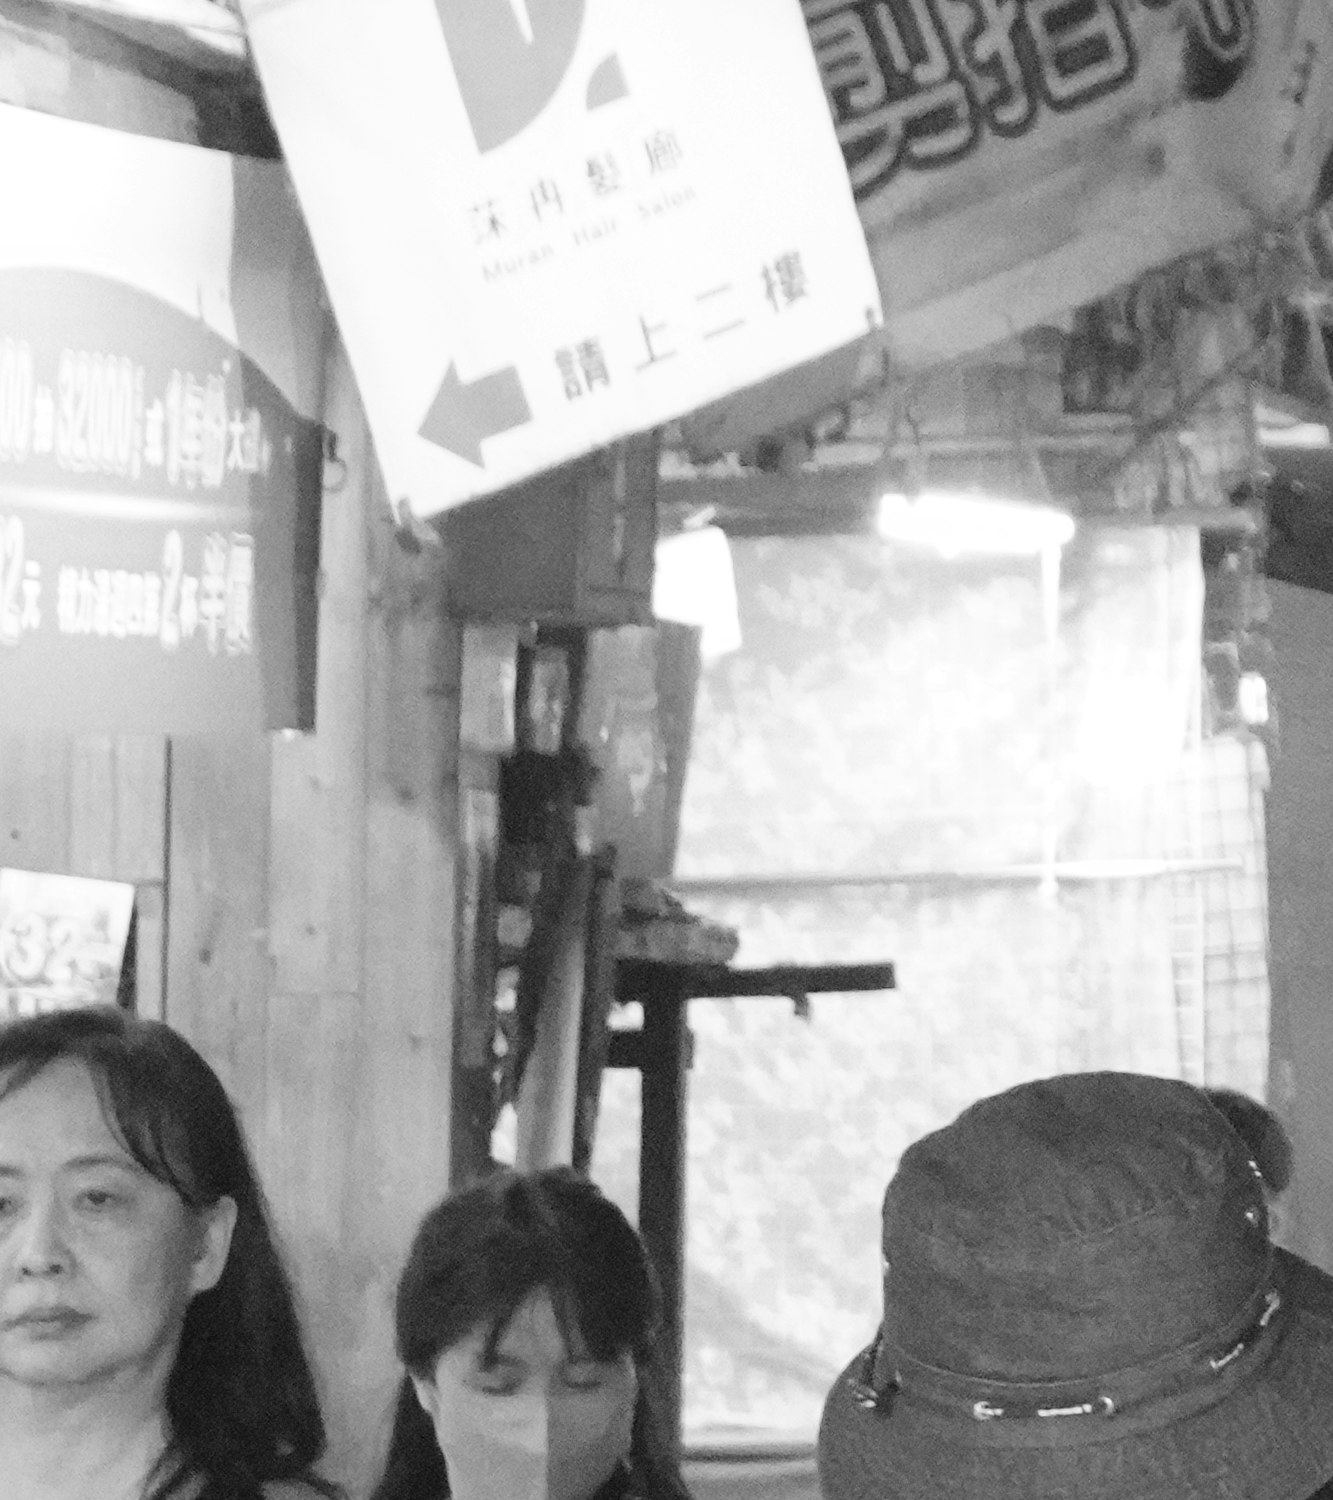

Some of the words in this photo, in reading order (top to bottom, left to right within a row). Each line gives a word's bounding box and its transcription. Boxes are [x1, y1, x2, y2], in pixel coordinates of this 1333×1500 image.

[572, 217, 622, 252] Hair
[636, 186, 698, 227] Salon
[554, 251, 811, 400] 請上二樓
